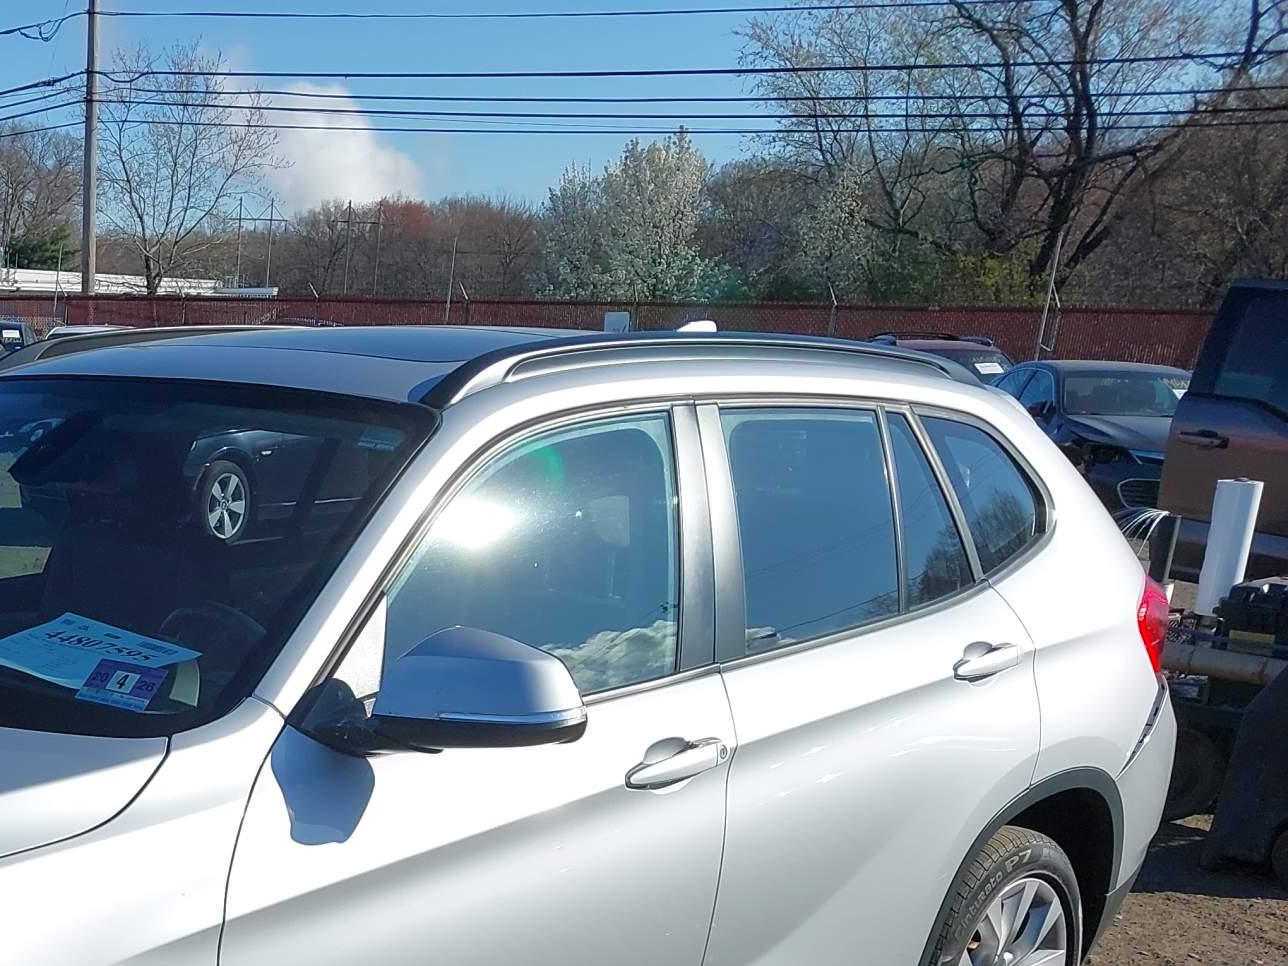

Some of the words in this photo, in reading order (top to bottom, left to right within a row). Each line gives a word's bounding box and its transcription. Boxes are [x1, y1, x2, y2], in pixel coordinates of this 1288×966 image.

[44, 630, 159, 661] 44807595
[116, 674, 130, 690] 4
[136, 680, 156, 692] 26
[1004, 848, 1033, 873] P7
